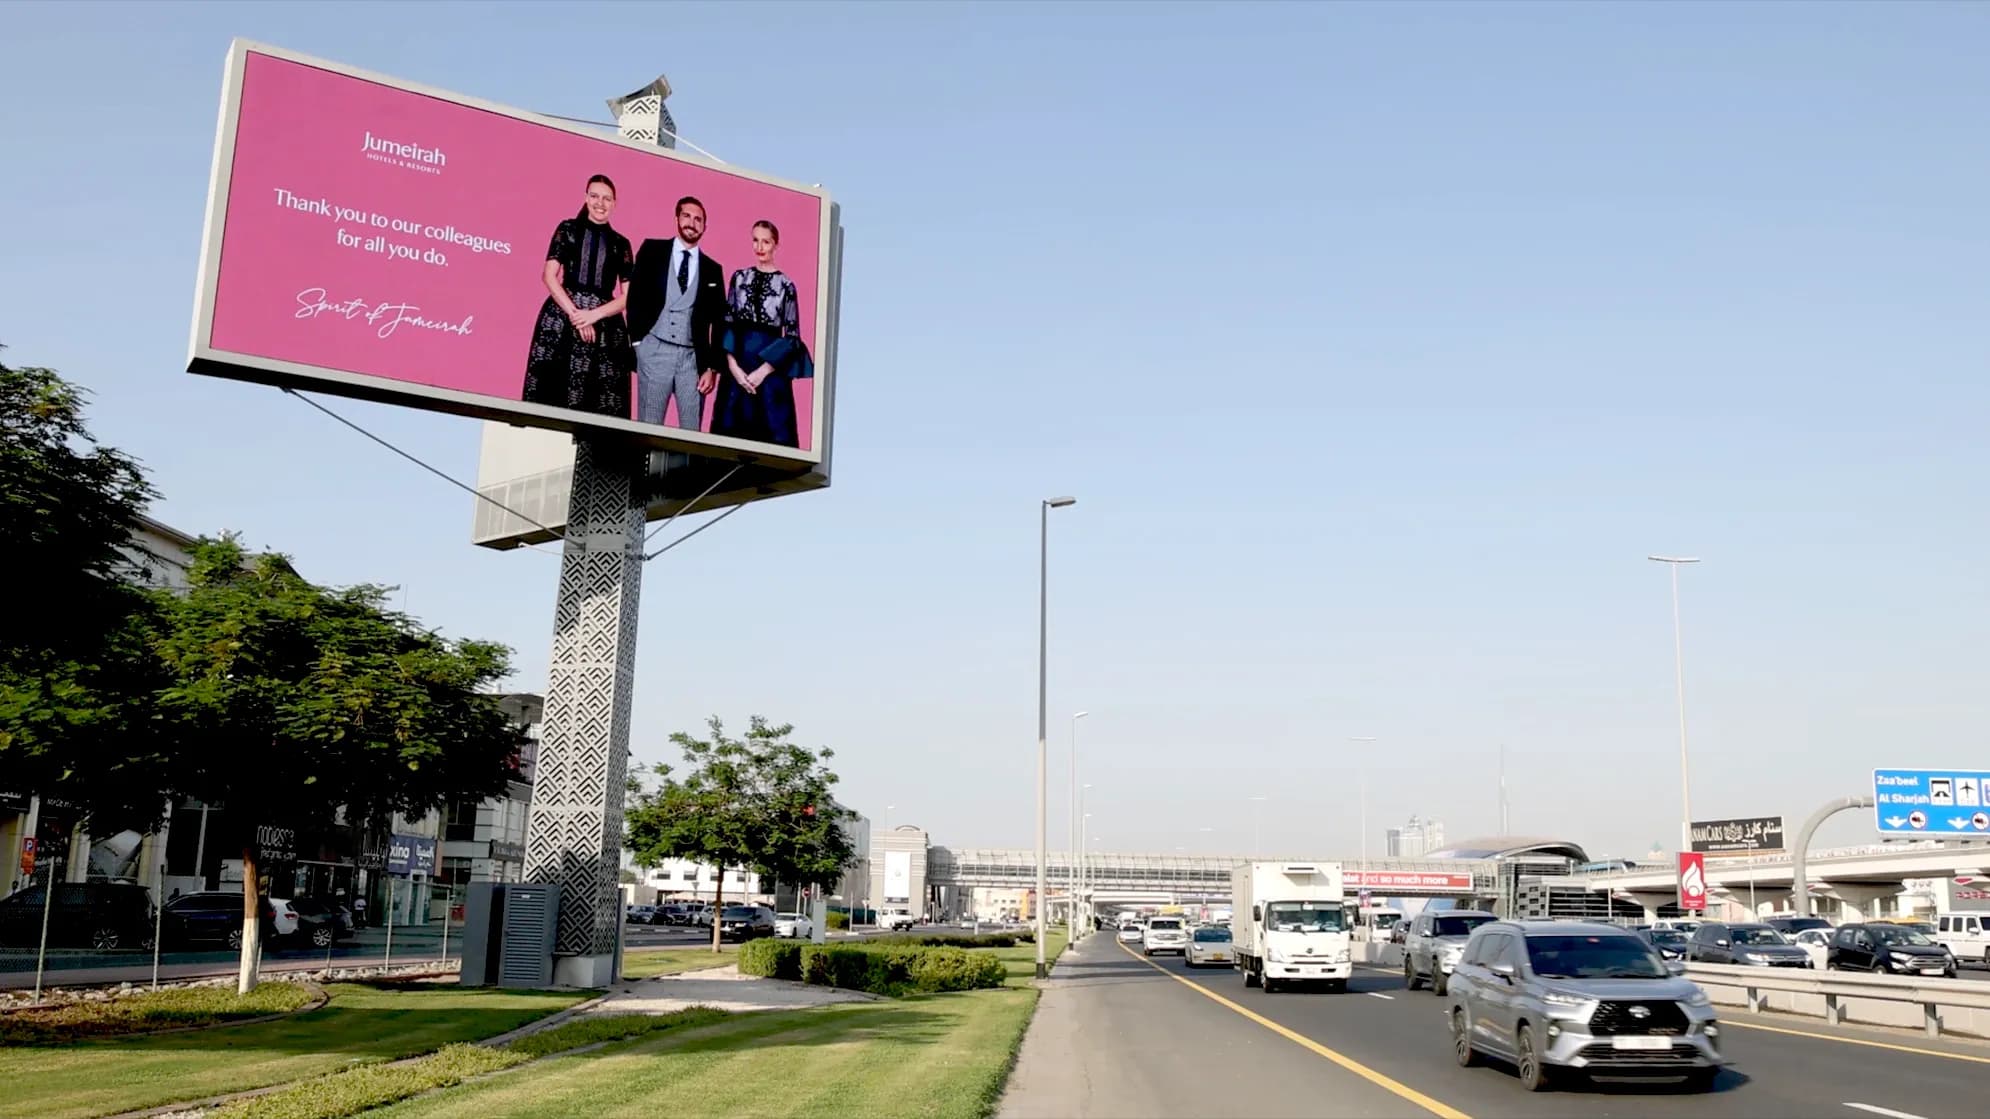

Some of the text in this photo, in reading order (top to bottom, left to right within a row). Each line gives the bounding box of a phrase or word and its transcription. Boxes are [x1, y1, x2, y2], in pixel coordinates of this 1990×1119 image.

[361, 131, 446, 166] Jumeirah
[367, 152, 397, 165] HOTELS
[407, 162, 441, 175] RESORTS
[274, 188, 511, 254] Thank you to our colleagues
[337, 228, 448, 266] for all you do.
[295, 287, 368, 319] Spirit
[1891, 793, 1930, 805] Sharjah
[1394, 875, 1421, 885] much
